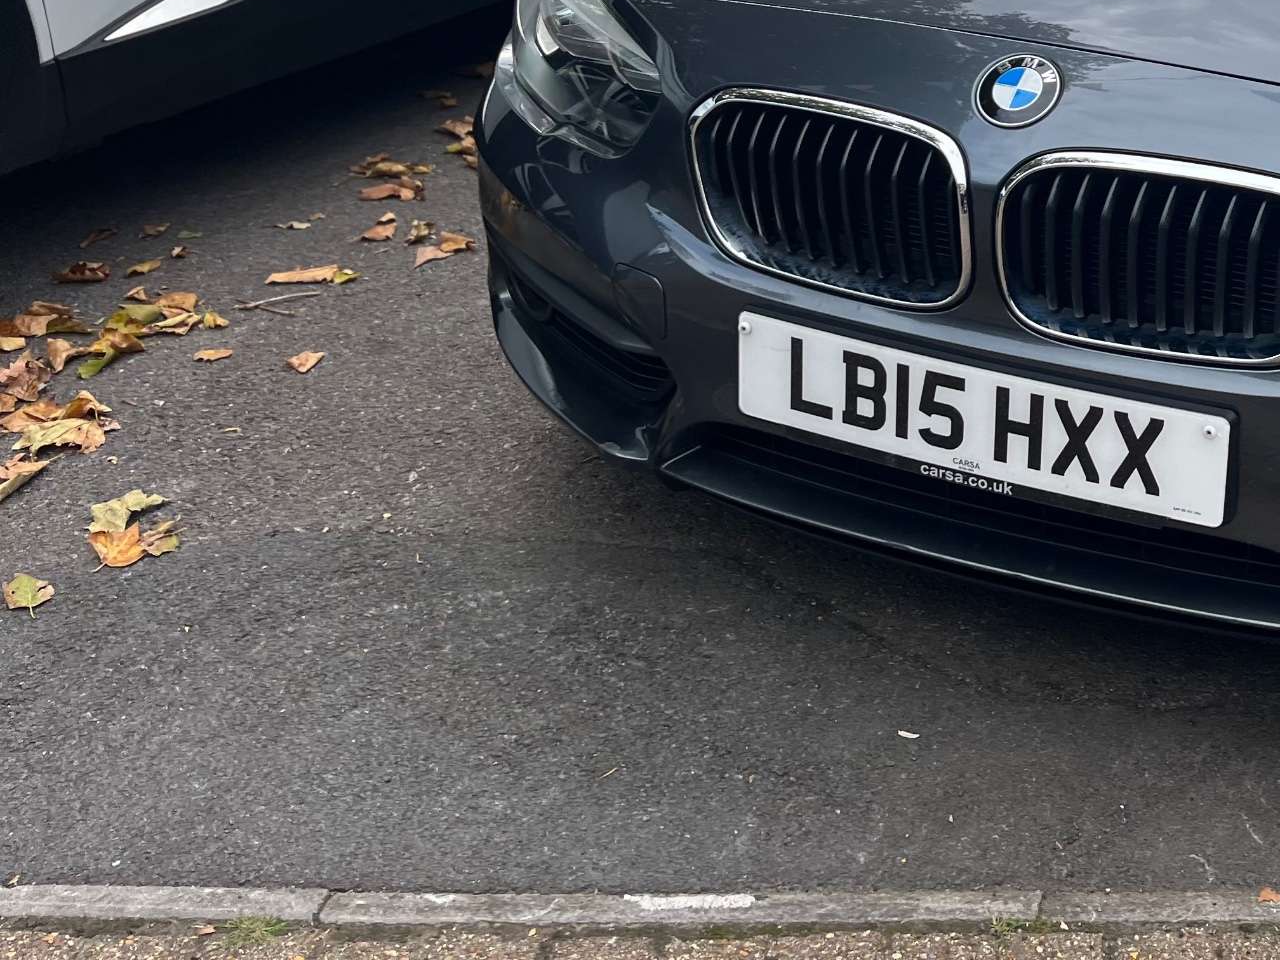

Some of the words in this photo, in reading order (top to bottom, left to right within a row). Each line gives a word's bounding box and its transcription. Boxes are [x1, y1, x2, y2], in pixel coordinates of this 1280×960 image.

[997, 56, 1057, 83] BMW
[790, 336, 966, 452] LB15
[993, 385, 1165, 497] HXX
[952, 457, 981, 470] CARSA
[919, 463, 1014, 496] carsa.co.uk
